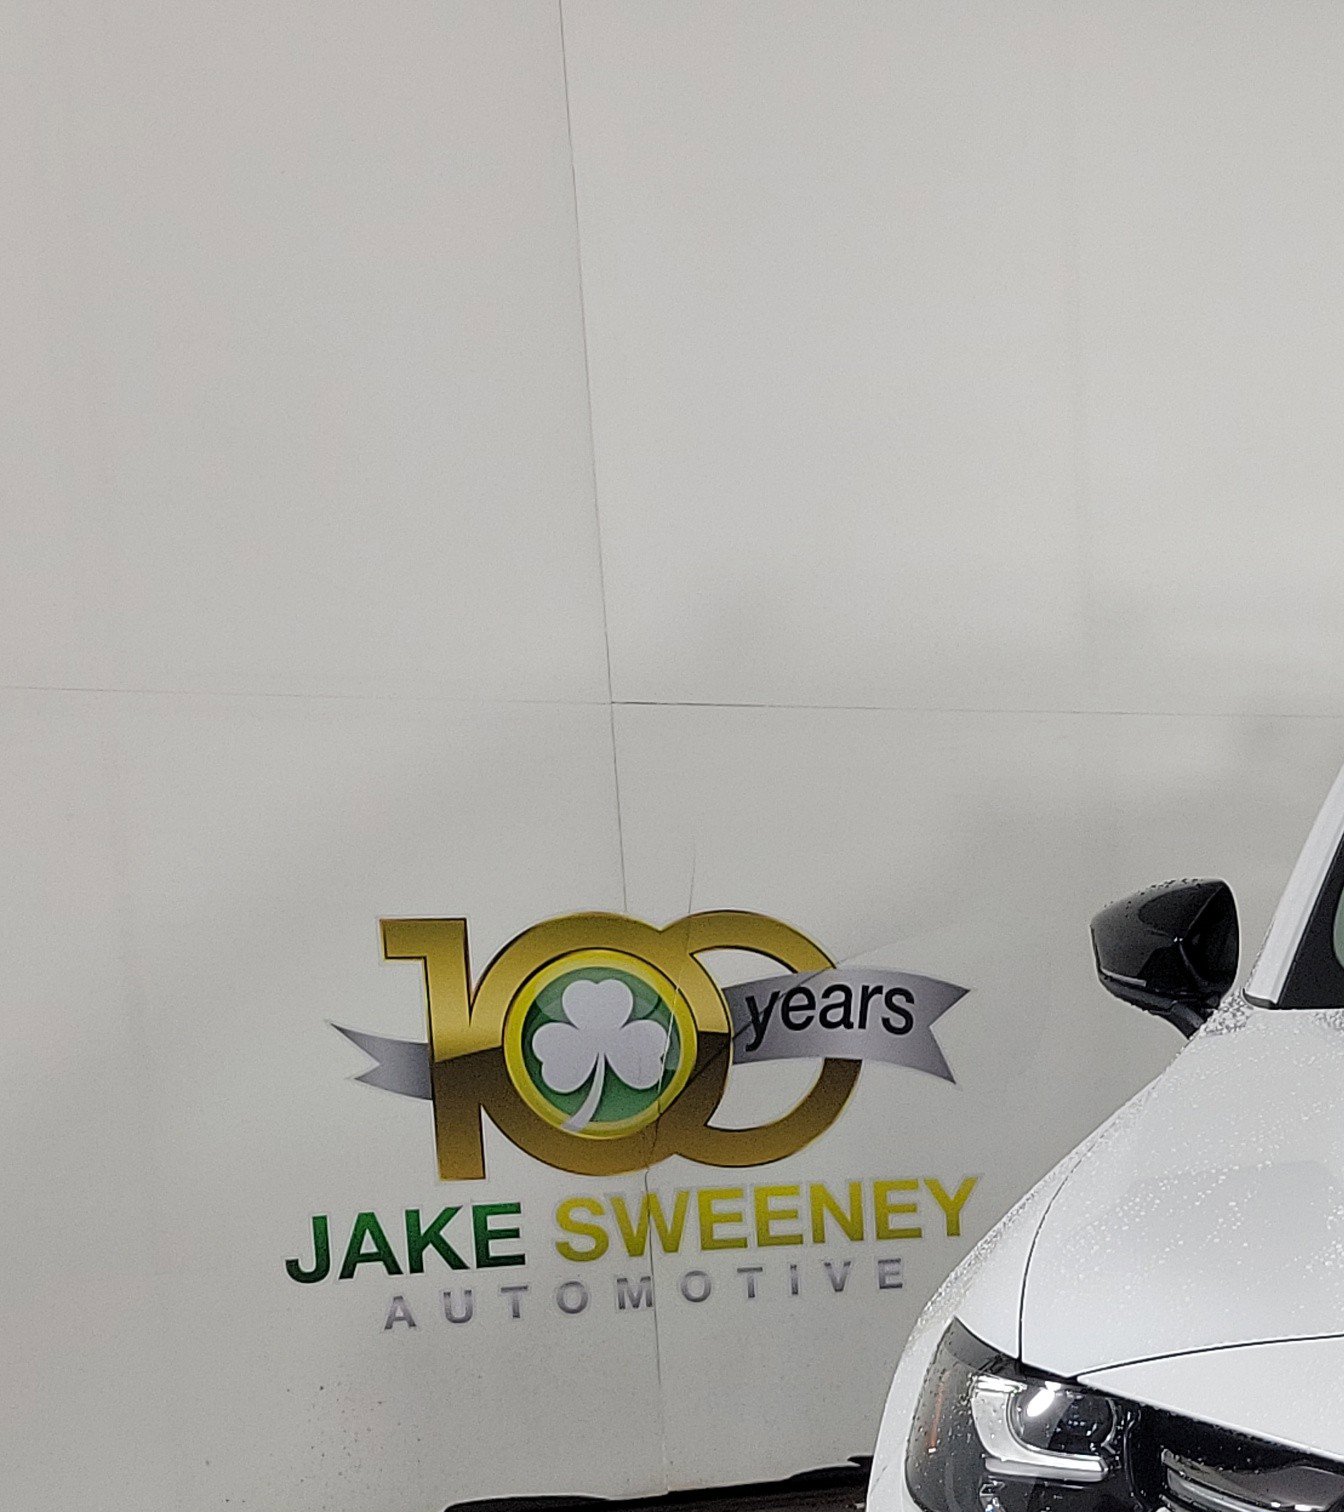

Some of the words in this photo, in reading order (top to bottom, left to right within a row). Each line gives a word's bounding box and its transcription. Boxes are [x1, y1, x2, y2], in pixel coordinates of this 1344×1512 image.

[379, 910, 863, 1180] 100
[744, 983, 917, 1051] years
[285, 1201, 526, 1284] JAKE
[554, 1177, 977, 1263] SWEENEY
[384, 1258, 904, 1331] AUTOMOTIVE
